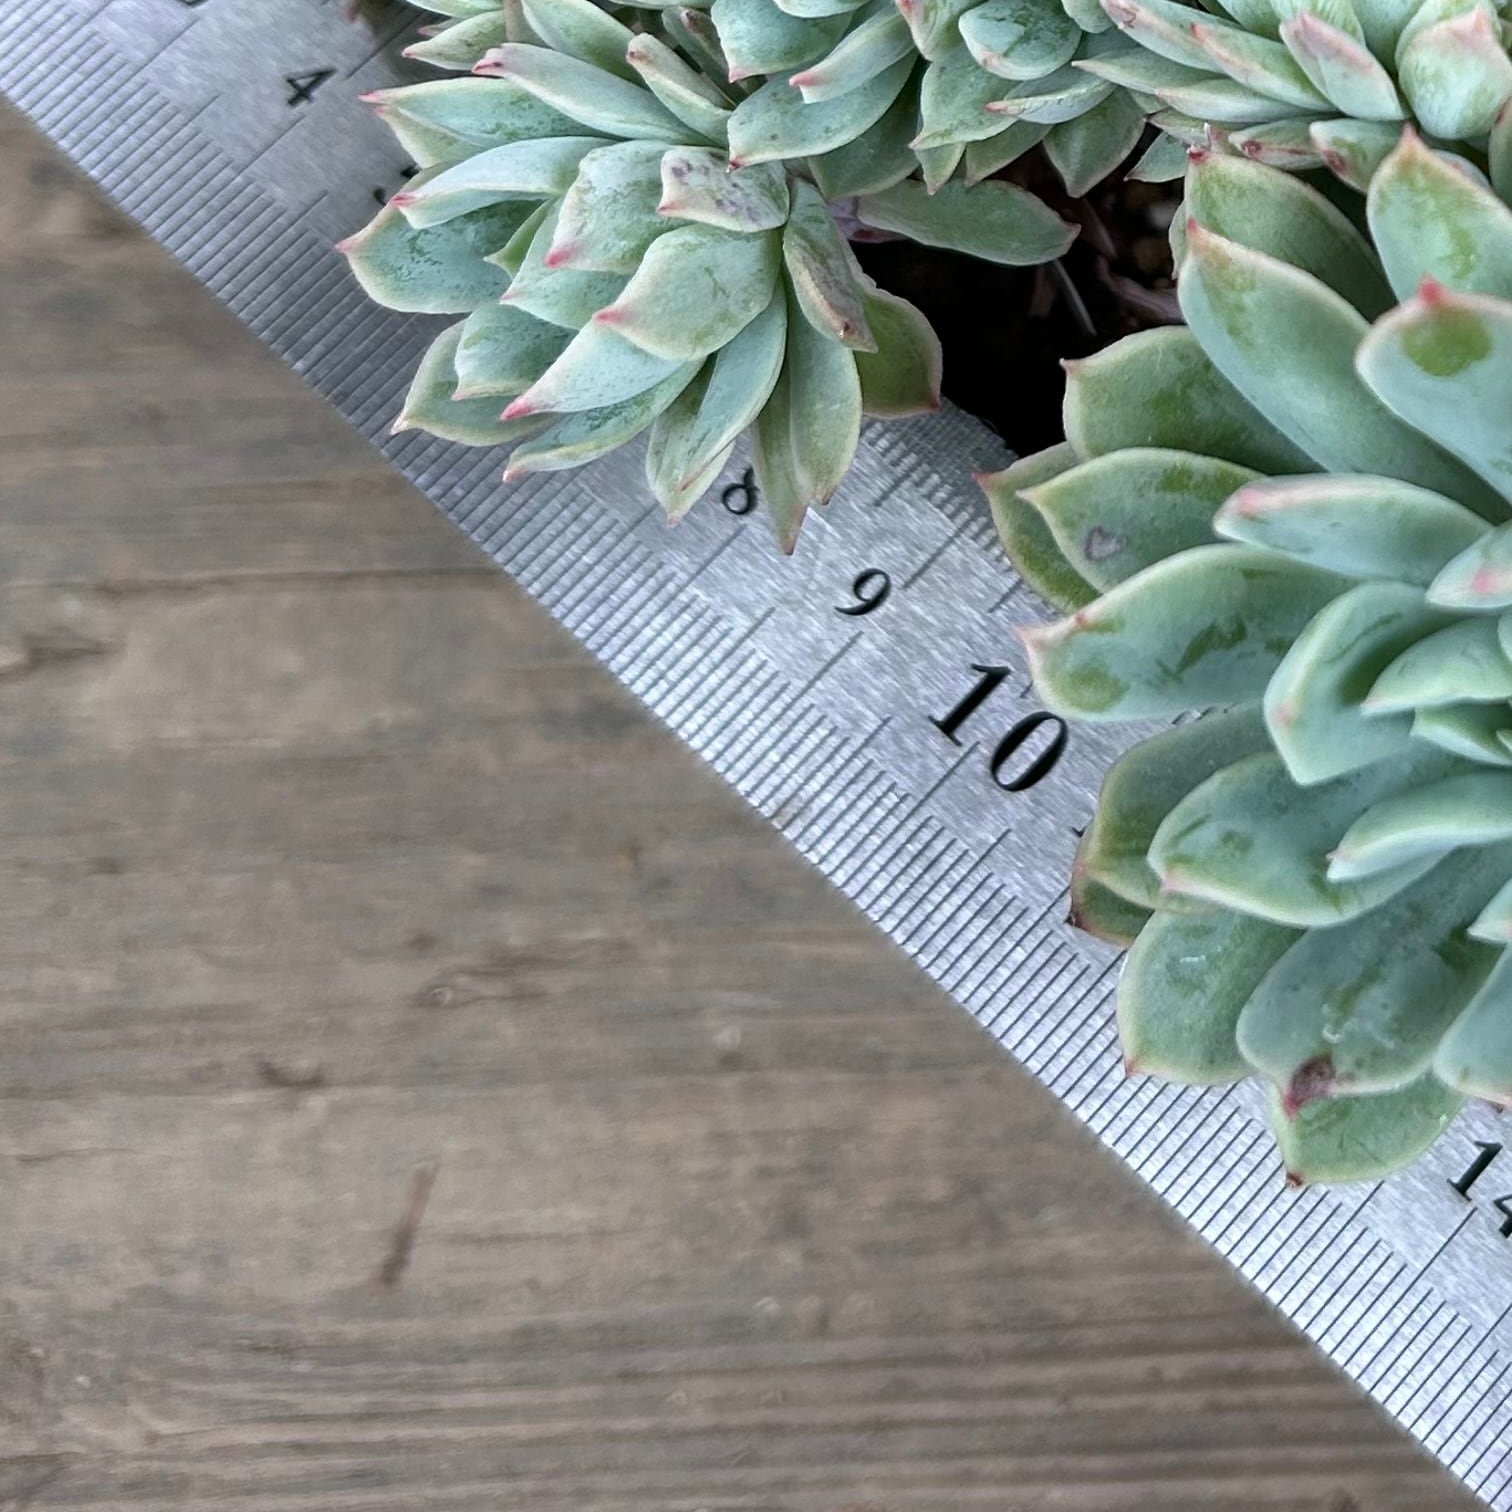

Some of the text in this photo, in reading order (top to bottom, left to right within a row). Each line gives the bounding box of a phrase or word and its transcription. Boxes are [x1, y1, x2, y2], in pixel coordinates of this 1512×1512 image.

[285, 66, 335, 107] 4
[834, 568, 892, 617] 9
[928, 662, 1070, 793] 10
